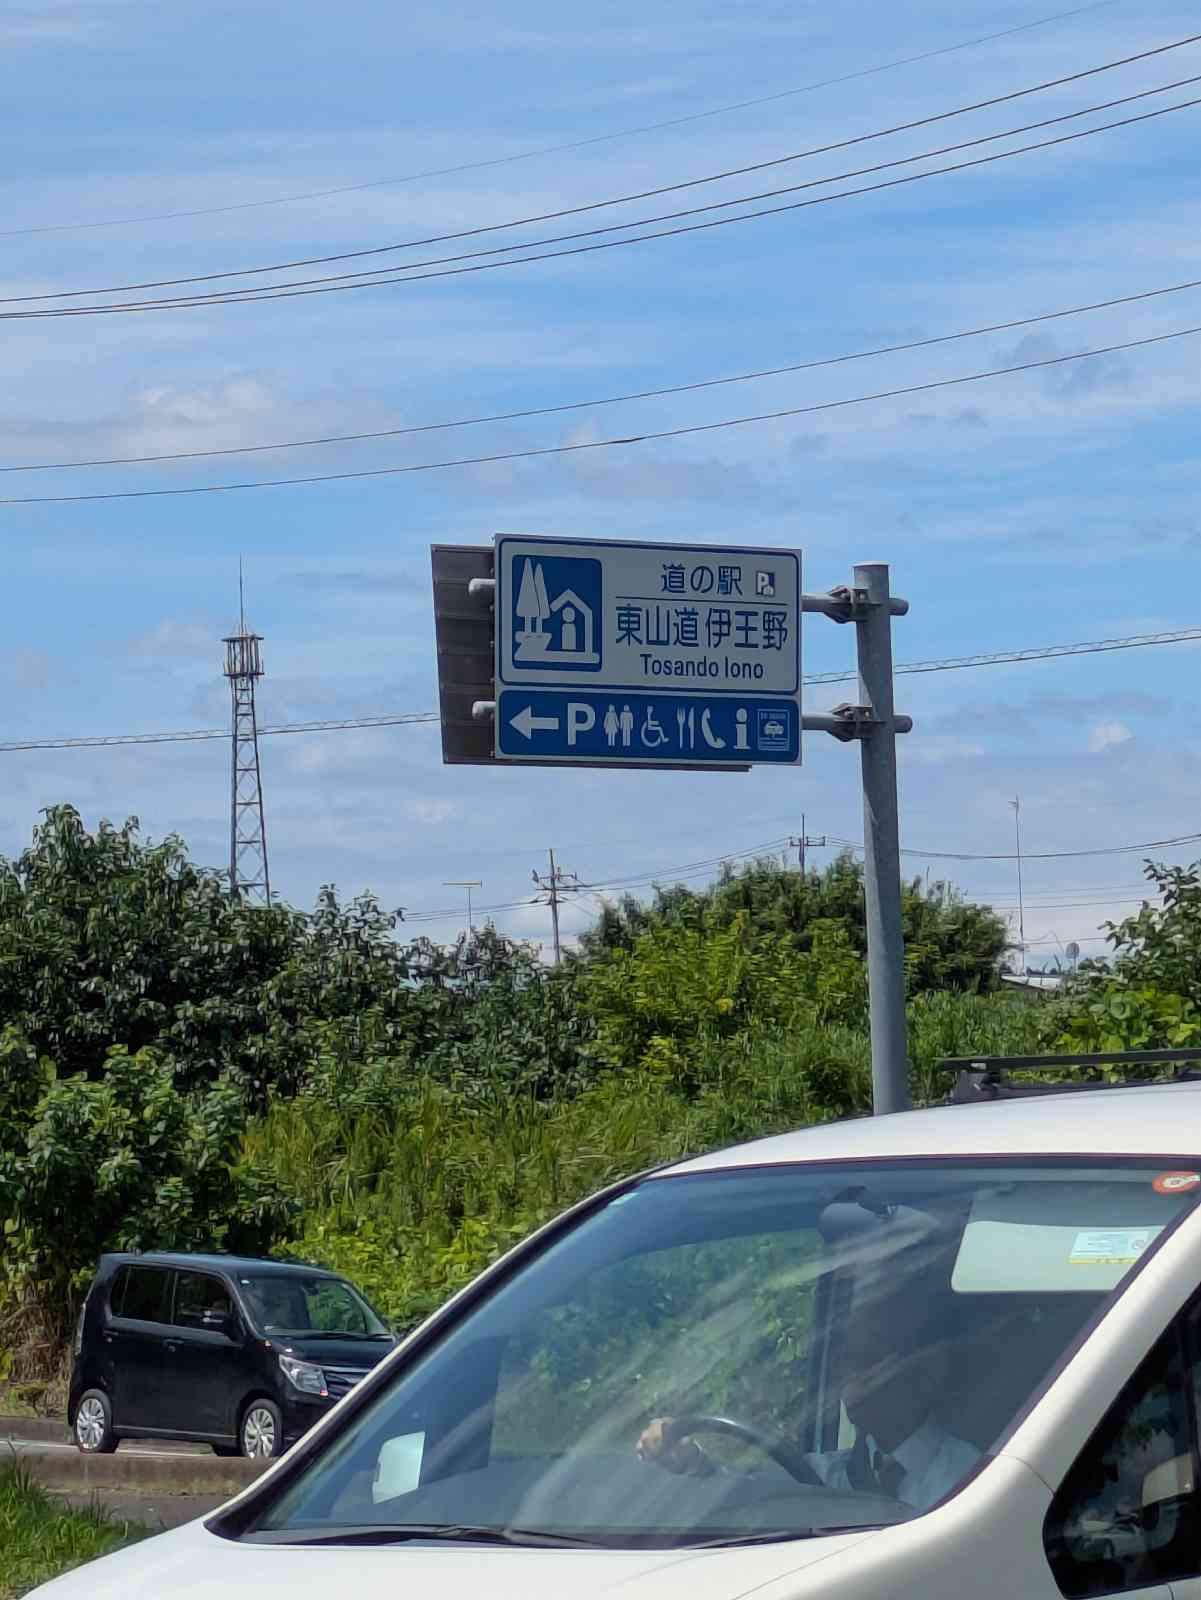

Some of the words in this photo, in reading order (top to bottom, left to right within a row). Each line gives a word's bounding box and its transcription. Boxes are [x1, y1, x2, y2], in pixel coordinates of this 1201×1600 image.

[660, 561, 743, 596] 道の駅
[615, 603, 788, 651] 東山道伊王野
[640, 653, 719, 678] Tosando
[725, 656, 764, 680] Iono
[567, 703, 596, 745] P
